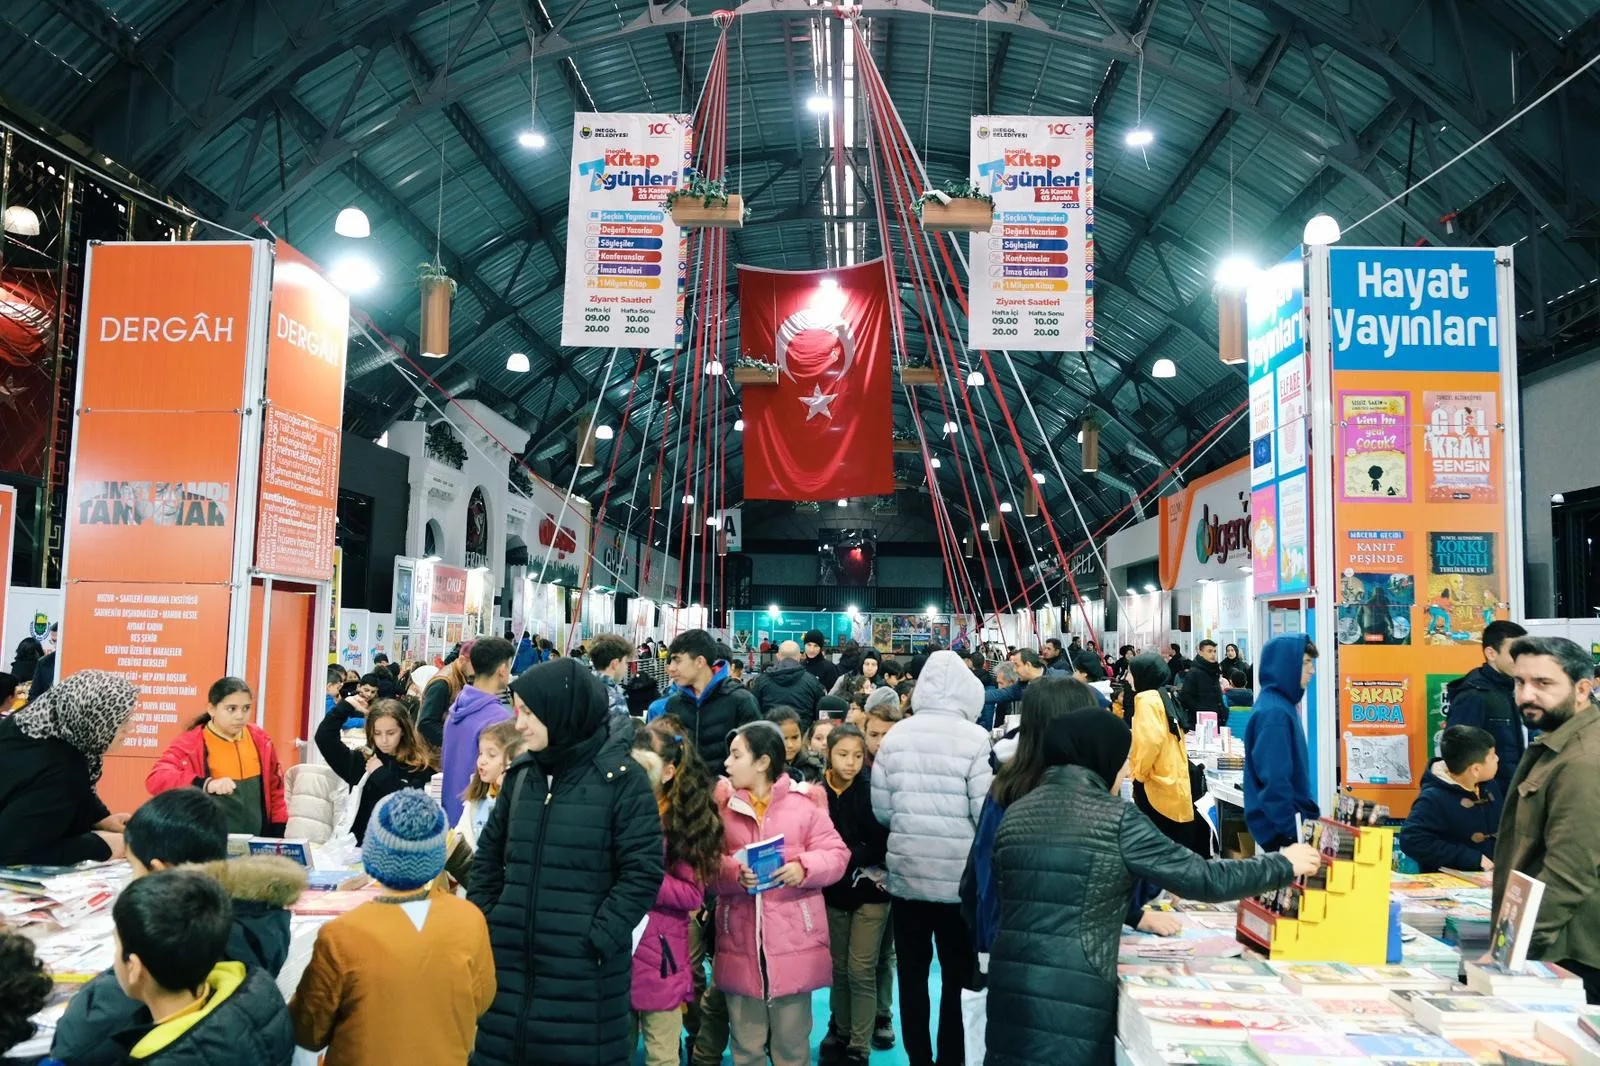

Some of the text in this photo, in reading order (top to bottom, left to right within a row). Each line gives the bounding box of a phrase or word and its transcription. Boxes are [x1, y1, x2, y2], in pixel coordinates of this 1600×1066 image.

[604, 168, 678, 190] günleri
[1004, 169, 1080, 190] günleri
[602, 226, 626, 234] Değerli
[1005, 228, 1030, 237] Değerli
[600, 239, 634, 248] Söyleşiler
[1004, 241, 1040, 250] Söyleşiler
[600, 252, 645, 261] Konferanslar
[1005, 255, 1050, 263] Konferanslar
[618, 266, 642, 274] Günleri
[1358, 261, 1469, 310] Hayat
[590, 295, 618, 304] Ziyaret
[996, 298, 1060, 306] Ziyaret Saatleri
[100, 313, 234, 342] DERGÂH
[624, 326, 650, 334] 20.00
[1433, 459, 1490, 472] SENSİN
[724, 516, 736, 536] A
[1356, 543, 1396, 552] KANIT
[1436, 540, 1488, 553] KORKU
[1349, 554, 1404, 565] PEŞİNDE
[1437, 553, 1488, 567] TÜNELİ
[1350, 688, 1404, 703] SAKAR
[1352, 704, 1404, 723] BORA
